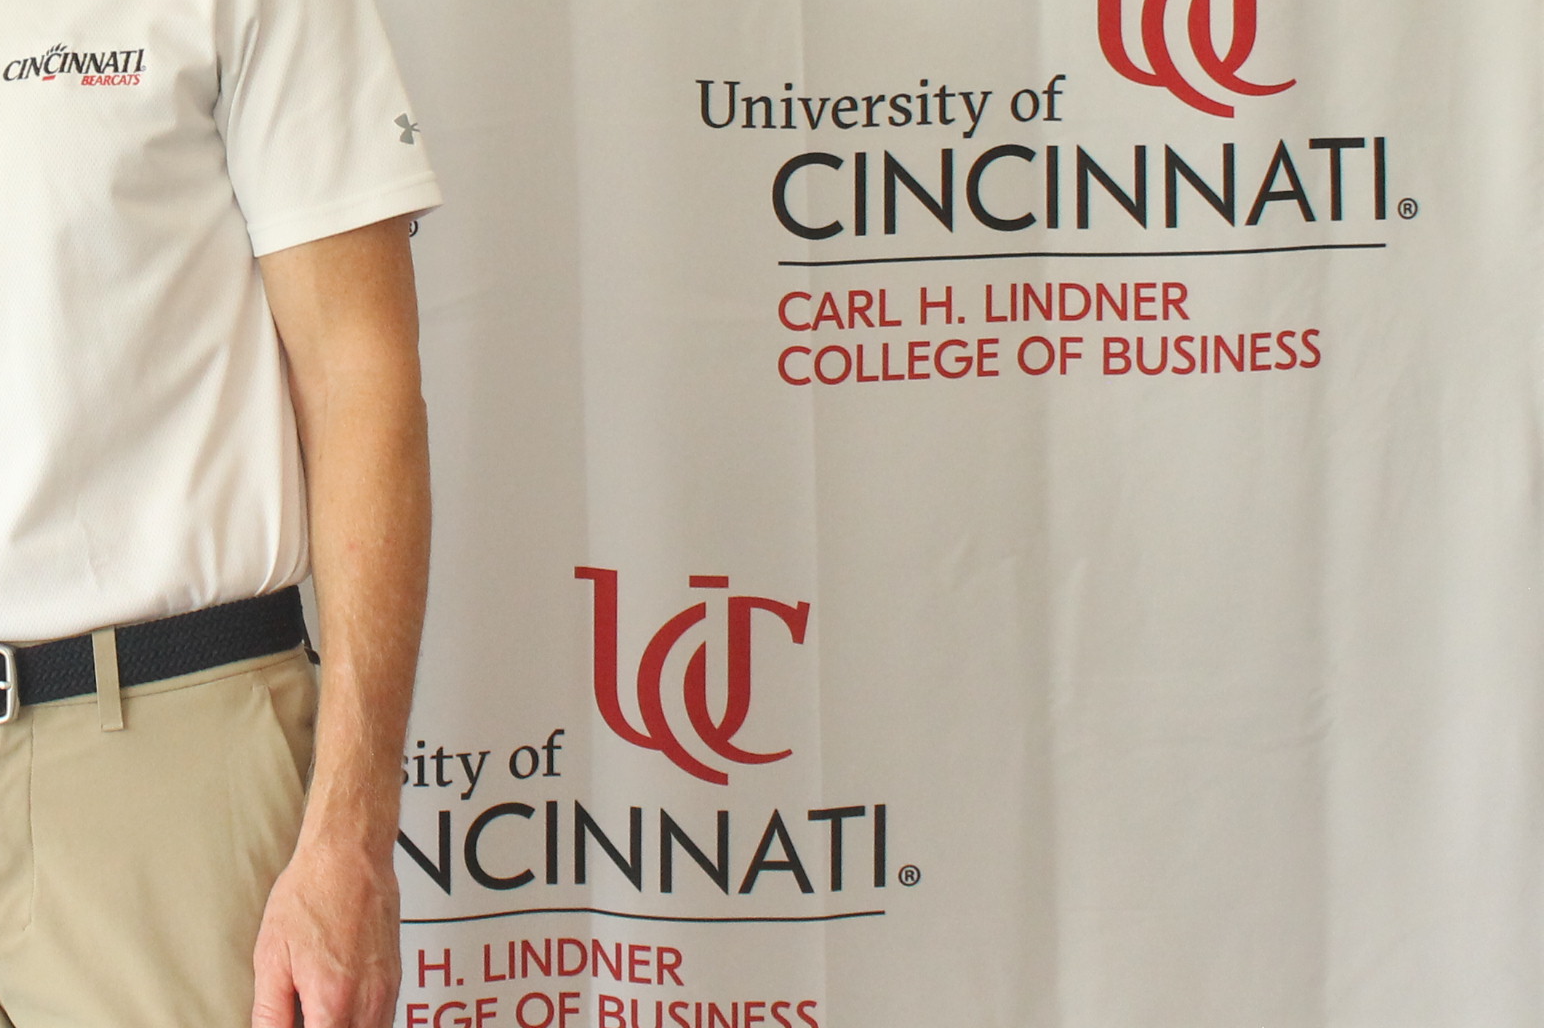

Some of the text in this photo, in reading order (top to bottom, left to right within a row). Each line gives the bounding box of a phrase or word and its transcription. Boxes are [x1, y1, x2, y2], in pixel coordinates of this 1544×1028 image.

[80, 73, 141, 87] BEARCATS
[695, 74, 1066, 139] University of
[778, 281, 1190, 332] CARL H. LINDNER
[777, 328, 1321, 386] COLLEGE OF BUSINESS
[508, 728, 566, 780] of
[417, 937, 685, 988] H. LINDNER
[515, 991, 582, 1028] OF
[598, 993, 820, 1028] BUSINESS
